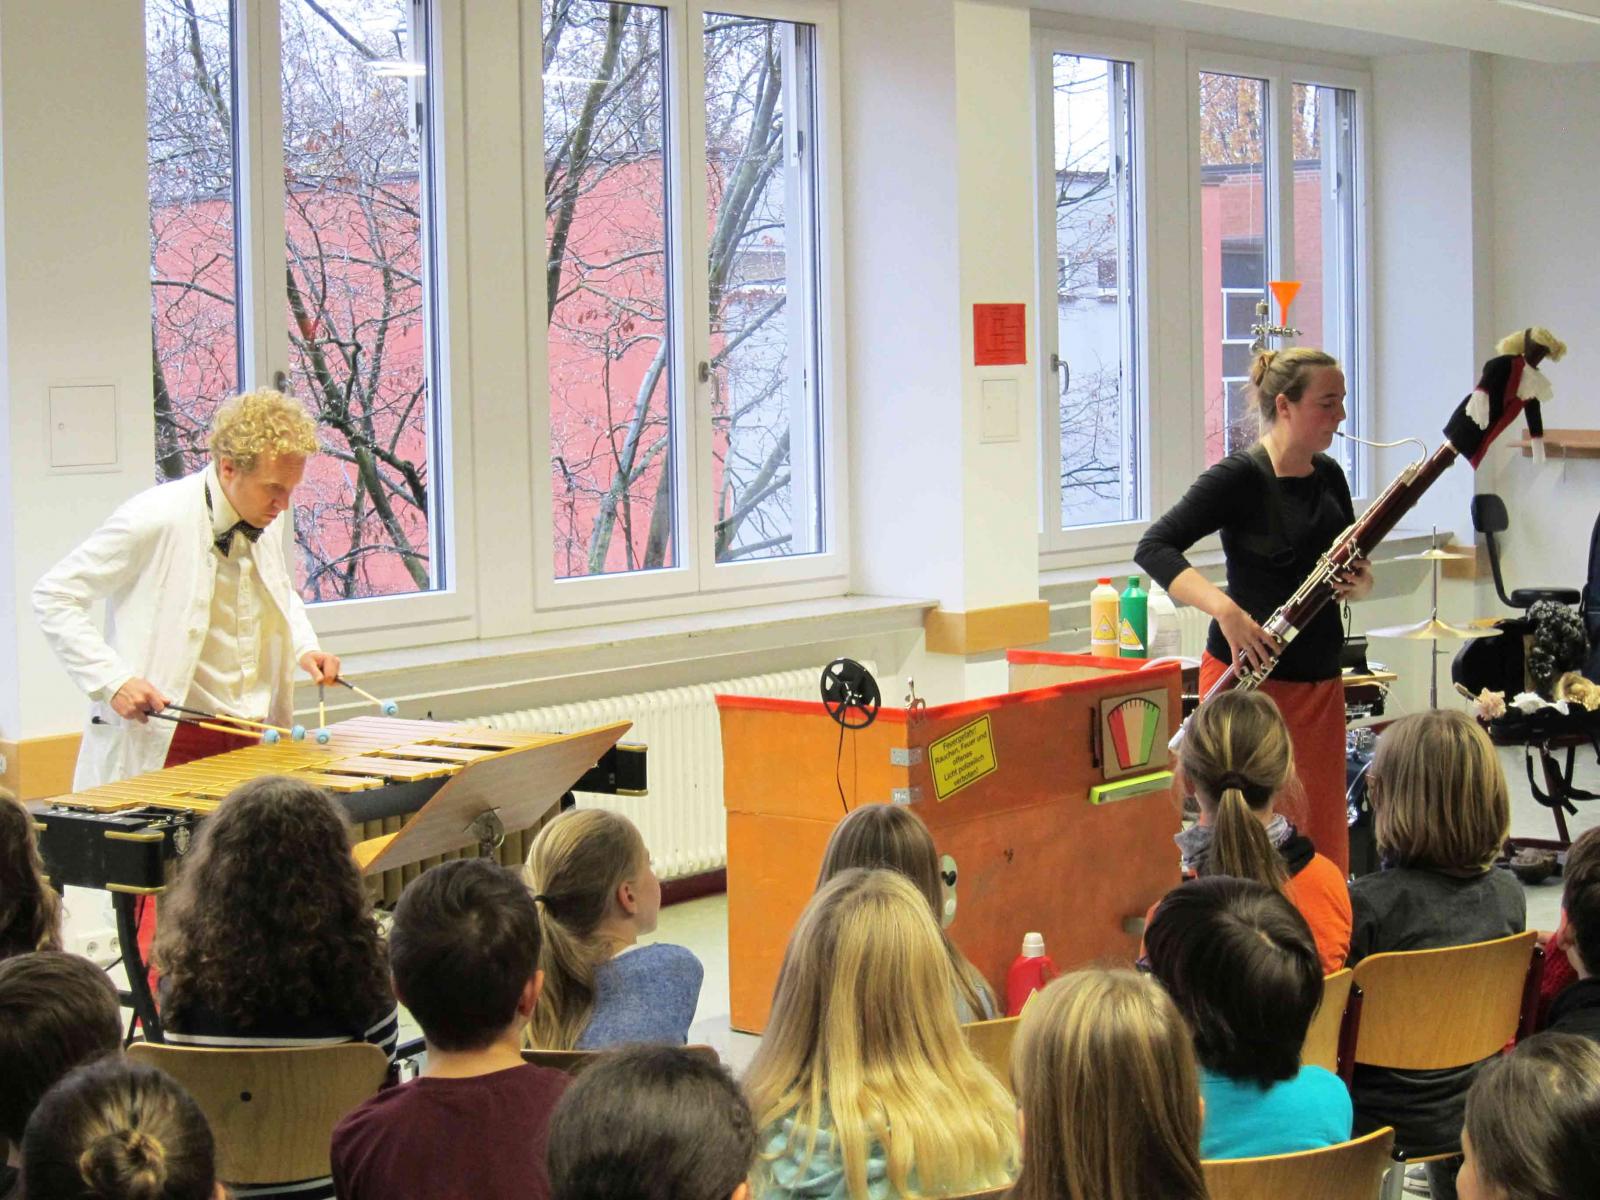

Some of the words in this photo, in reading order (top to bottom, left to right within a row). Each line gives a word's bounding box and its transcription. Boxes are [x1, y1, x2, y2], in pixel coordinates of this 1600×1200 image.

[935, 747, 960, 765] Rauchen,
[960, 738, 976, 750] Feuer
[977, 731, 988, 742] und
[952, 750, 973, 766] offenes
[944, 768, 959, 781] Licht
[958, 754, 985, 774] polizeilich
